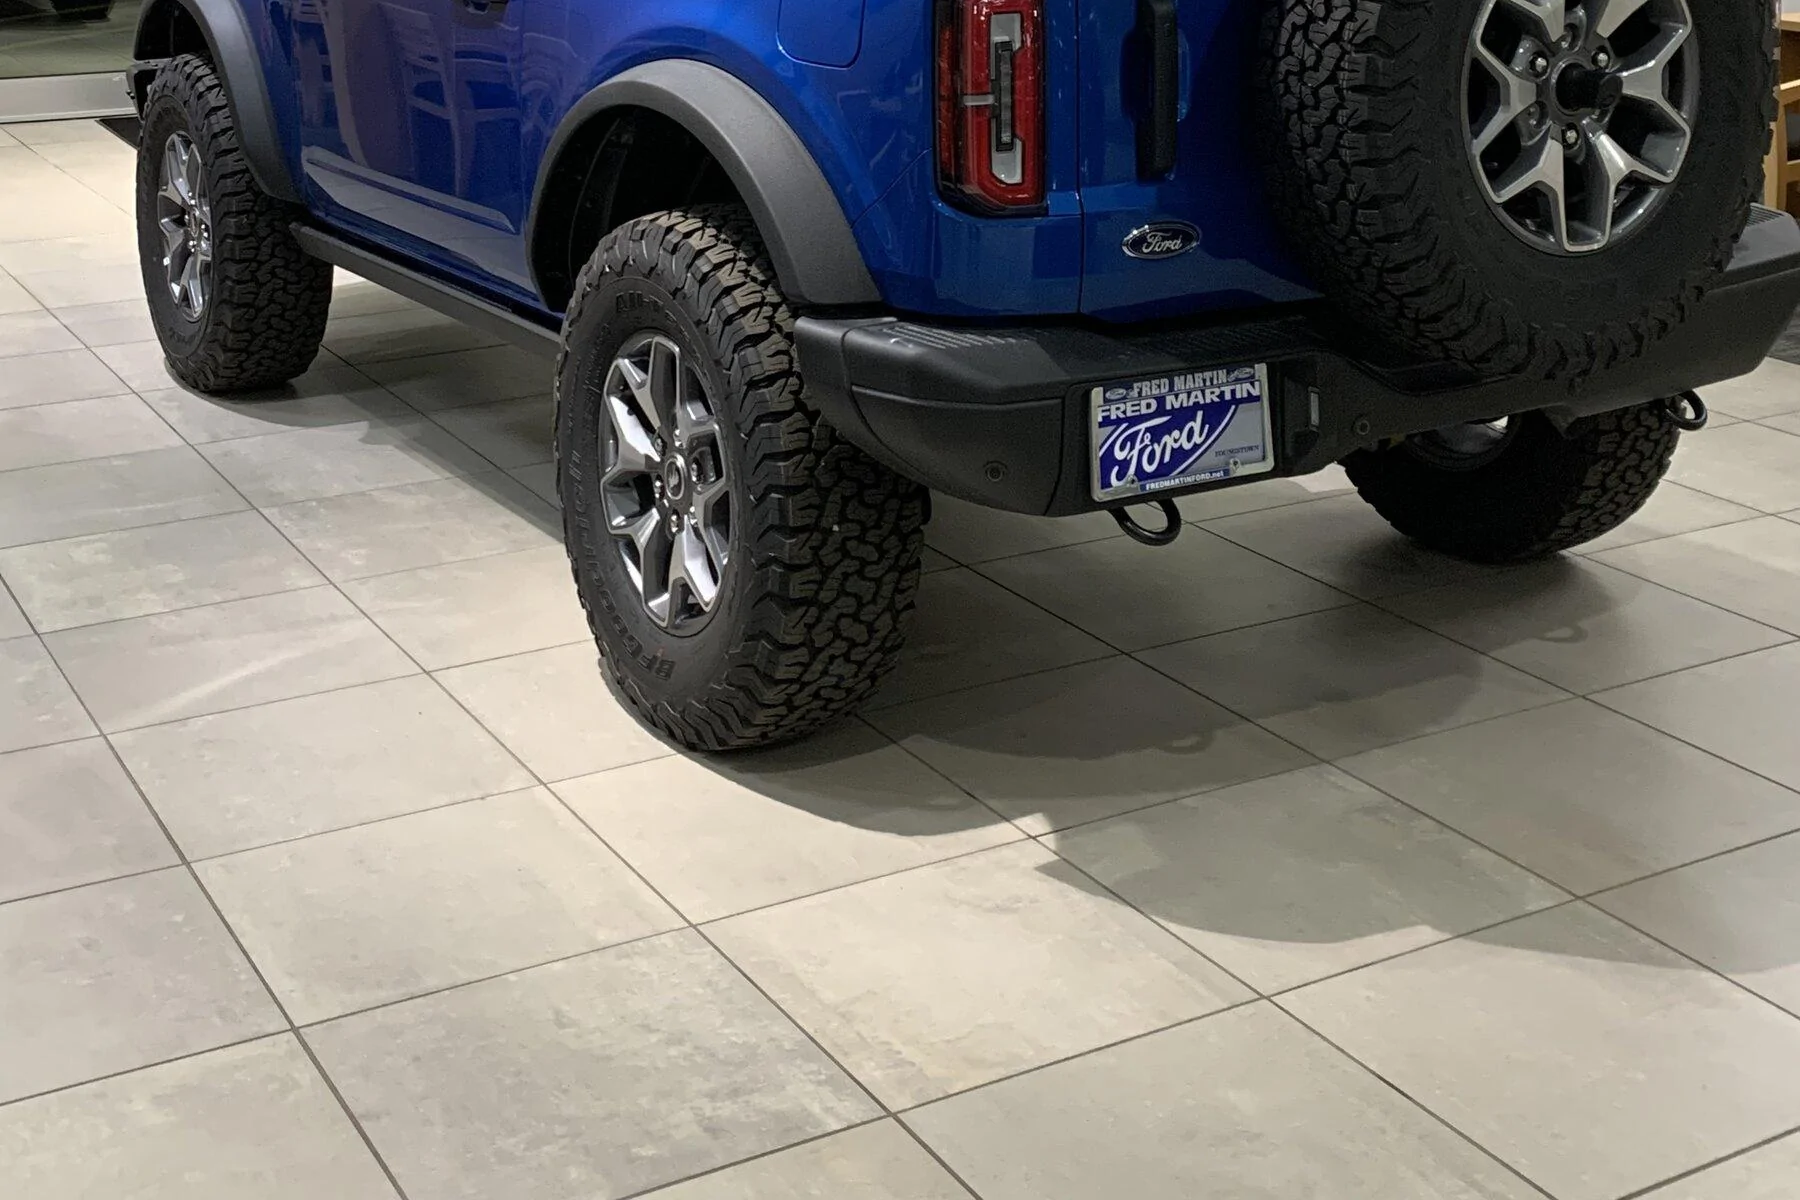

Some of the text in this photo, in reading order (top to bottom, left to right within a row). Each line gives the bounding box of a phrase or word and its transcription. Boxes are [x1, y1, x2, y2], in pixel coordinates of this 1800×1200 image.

[1142, 230, 1183, 254] Ford
[1132, 378, 1170, 398] FRED
[1173, 368, 1228, 392] MARTIN
[1097, 381, 1261, 423] FRED MARTIN
[1110, 410, 1210, 488] Ford
